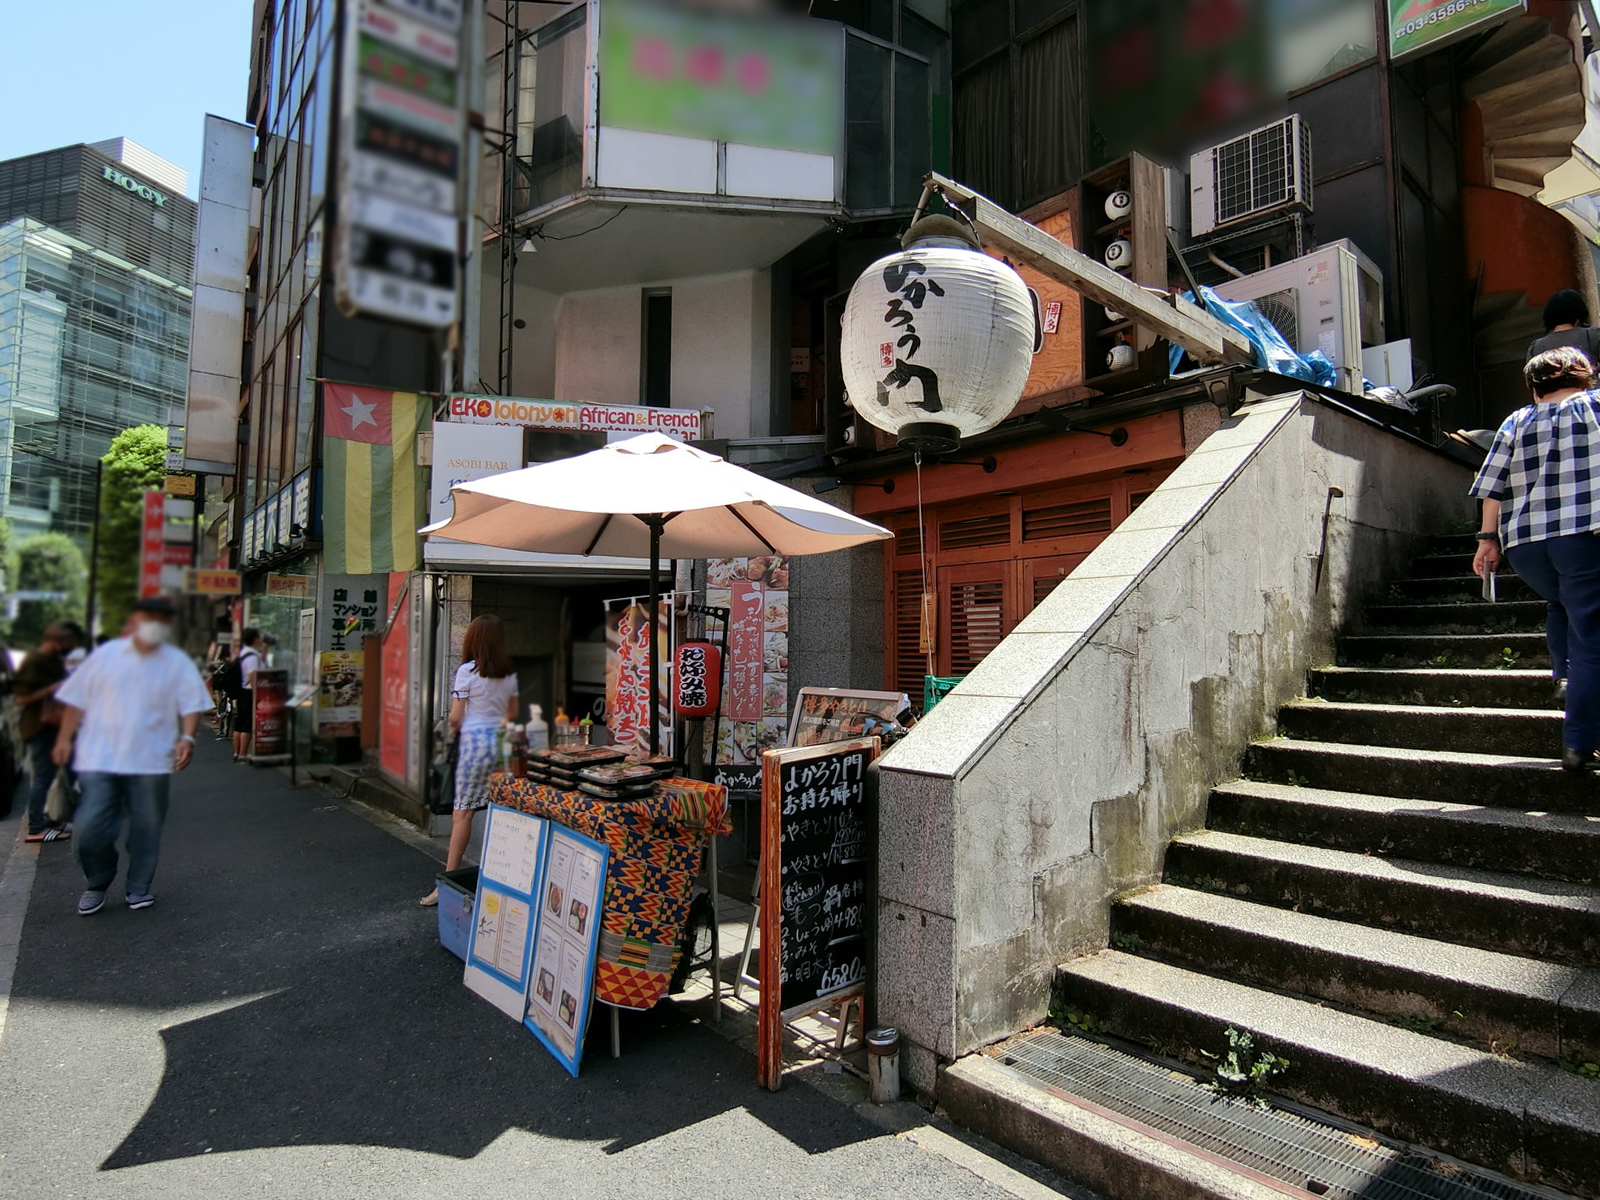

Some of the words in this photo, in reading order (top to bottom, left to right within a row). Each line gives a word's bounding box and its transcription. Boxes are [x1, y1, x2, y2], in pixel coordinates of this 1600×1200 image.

[103, 165, 169, 207] HOGY
[1046, 302, 1061, 332] 博多
[880, 341, 893, 367] 博多
[451, 397, 492, 418] EKO
[494, 401, 579, 423] lolonyon
[580, 407, 634, 425] African
[636, 413, 647, 425] &
[648, 409, 699, 428] French
[447, 459, 482, 469] ASOBI
[485, 460, 509, 470] BAR
[332, 603, 378, 617] マンション
[784, 753, 863, 793] よかろう門
[782, 781, 863, 816] お持ち帰り
[795, 940, 819, 959] みそ
